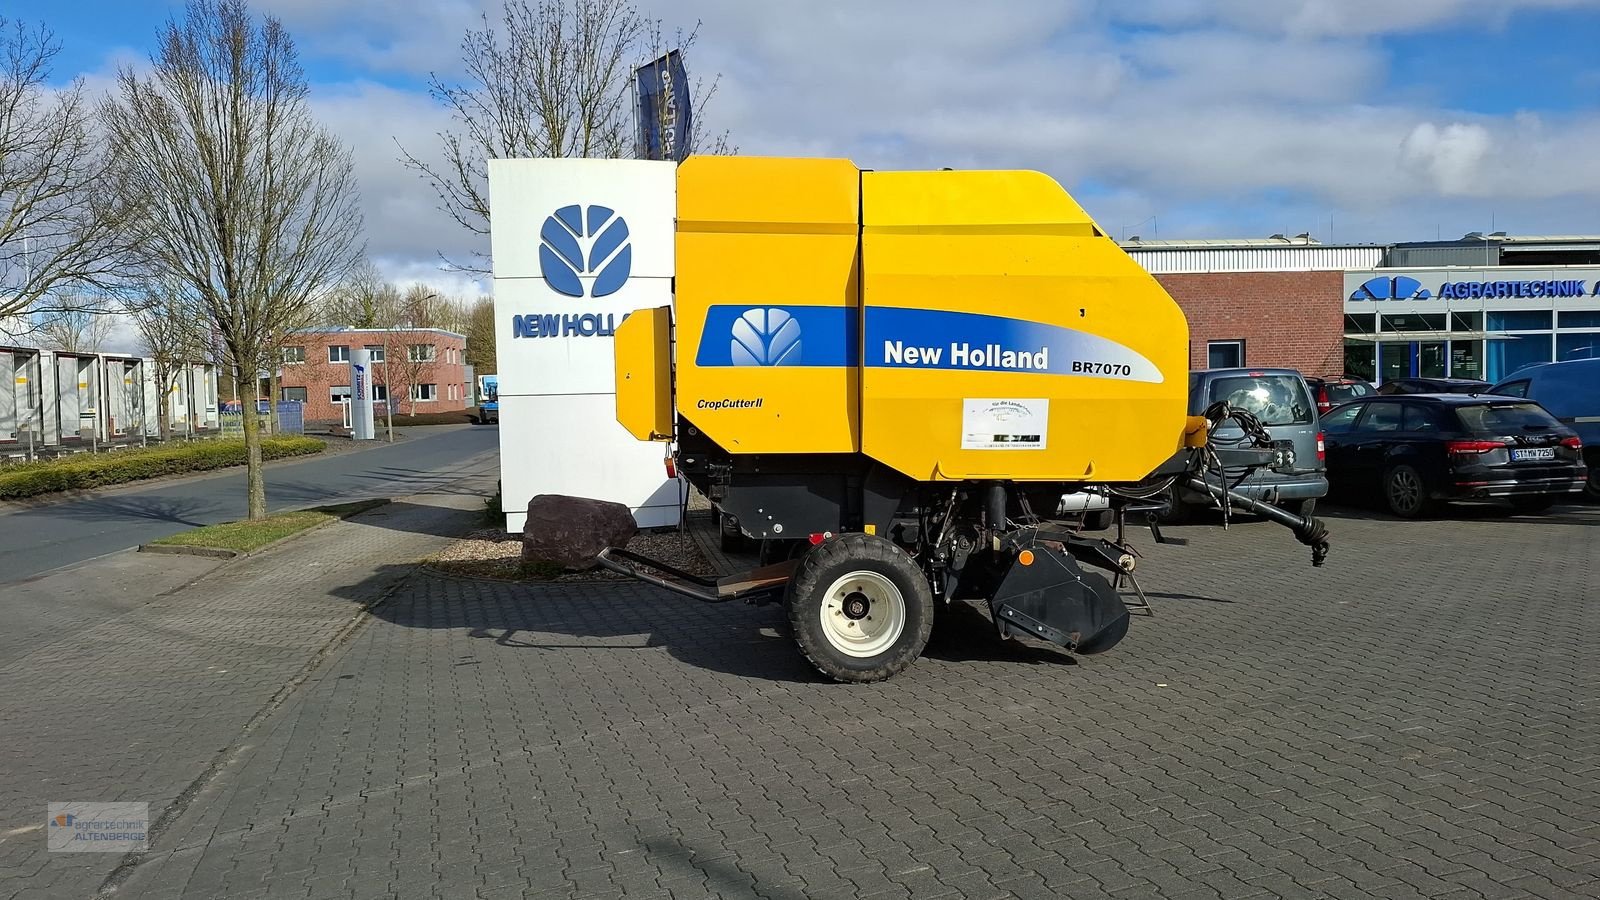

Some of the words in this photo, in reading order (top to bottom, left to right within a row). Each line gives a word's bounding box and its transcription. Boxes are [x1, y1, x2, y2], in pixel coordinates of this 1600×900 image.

[1438, 280, 1587, 298] AGRARTECHNIK
[513, 313, 561, 338] NEW
[562, 313, 631, 337] HOLL
[884, 340, 942, 365] New
[951, 342, 1048, 370] Holland
[1072, 361, 1131, 376] BR7070
